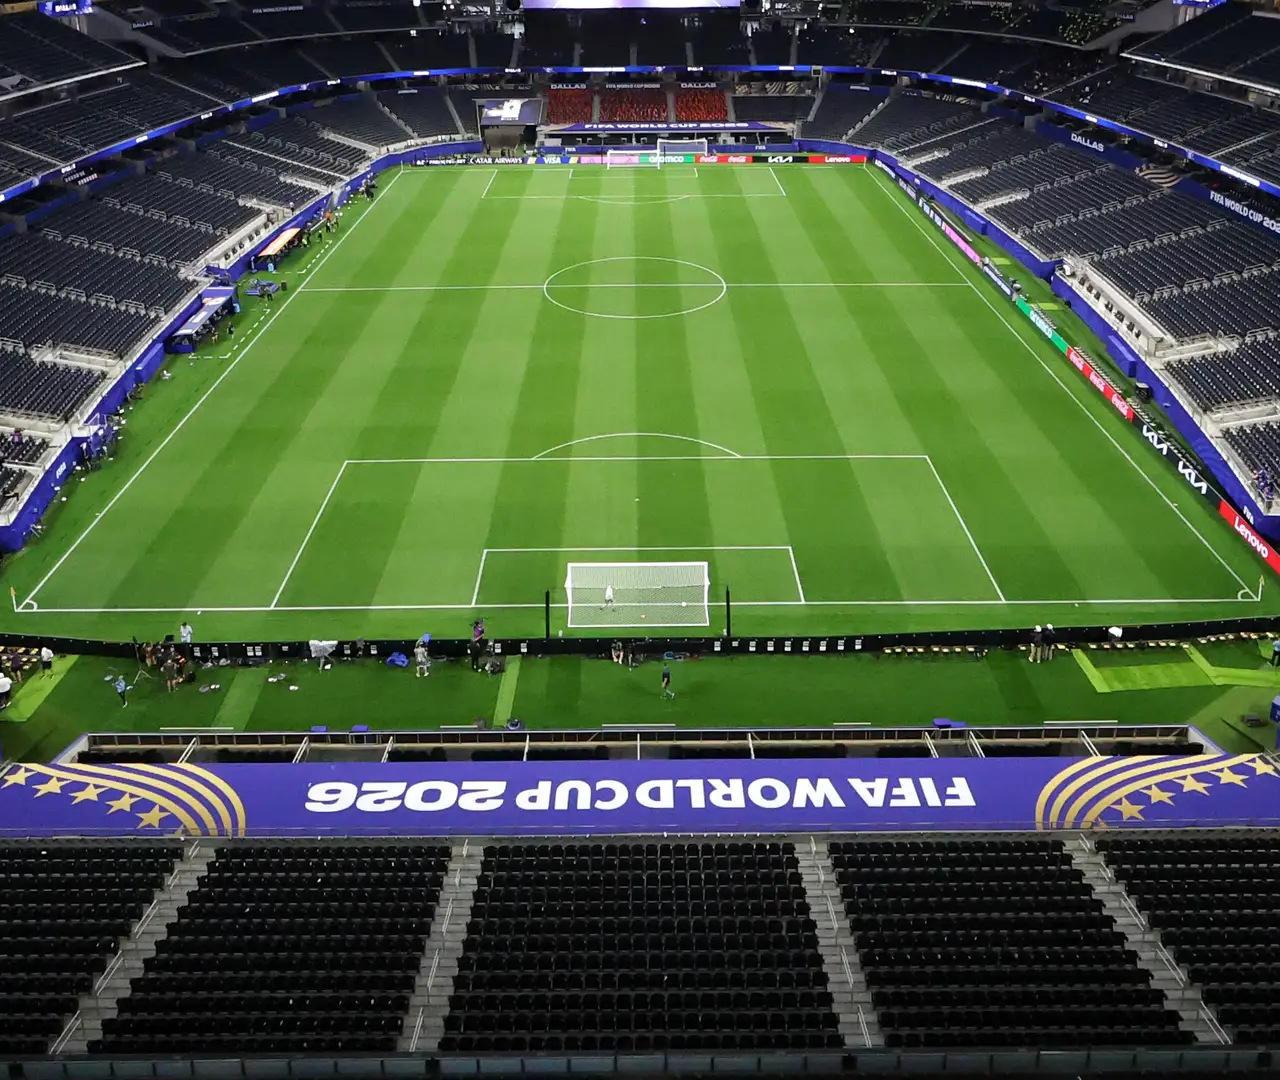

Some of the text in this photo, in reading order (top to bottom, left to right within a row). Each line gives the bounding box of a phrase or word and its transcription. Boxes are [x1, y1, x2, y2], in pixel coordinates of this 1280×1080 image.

[1071, 133, 1104, 152] DALLAS
[495, 156, 523, 164] AIRWAYS
[543, 156, 561, 164] VISA
[1210, 191, 1224, 206] FIFA
[1224, 197, 1248, 217] WORLD
[1248, 209, 1263, 223] CUP
[1243, 506, 1255, 525] FIFA
[1234, 516, 1268, 558] Lenovo
[305, 777, 976, 812] FIFA WORLD CUP 2026
